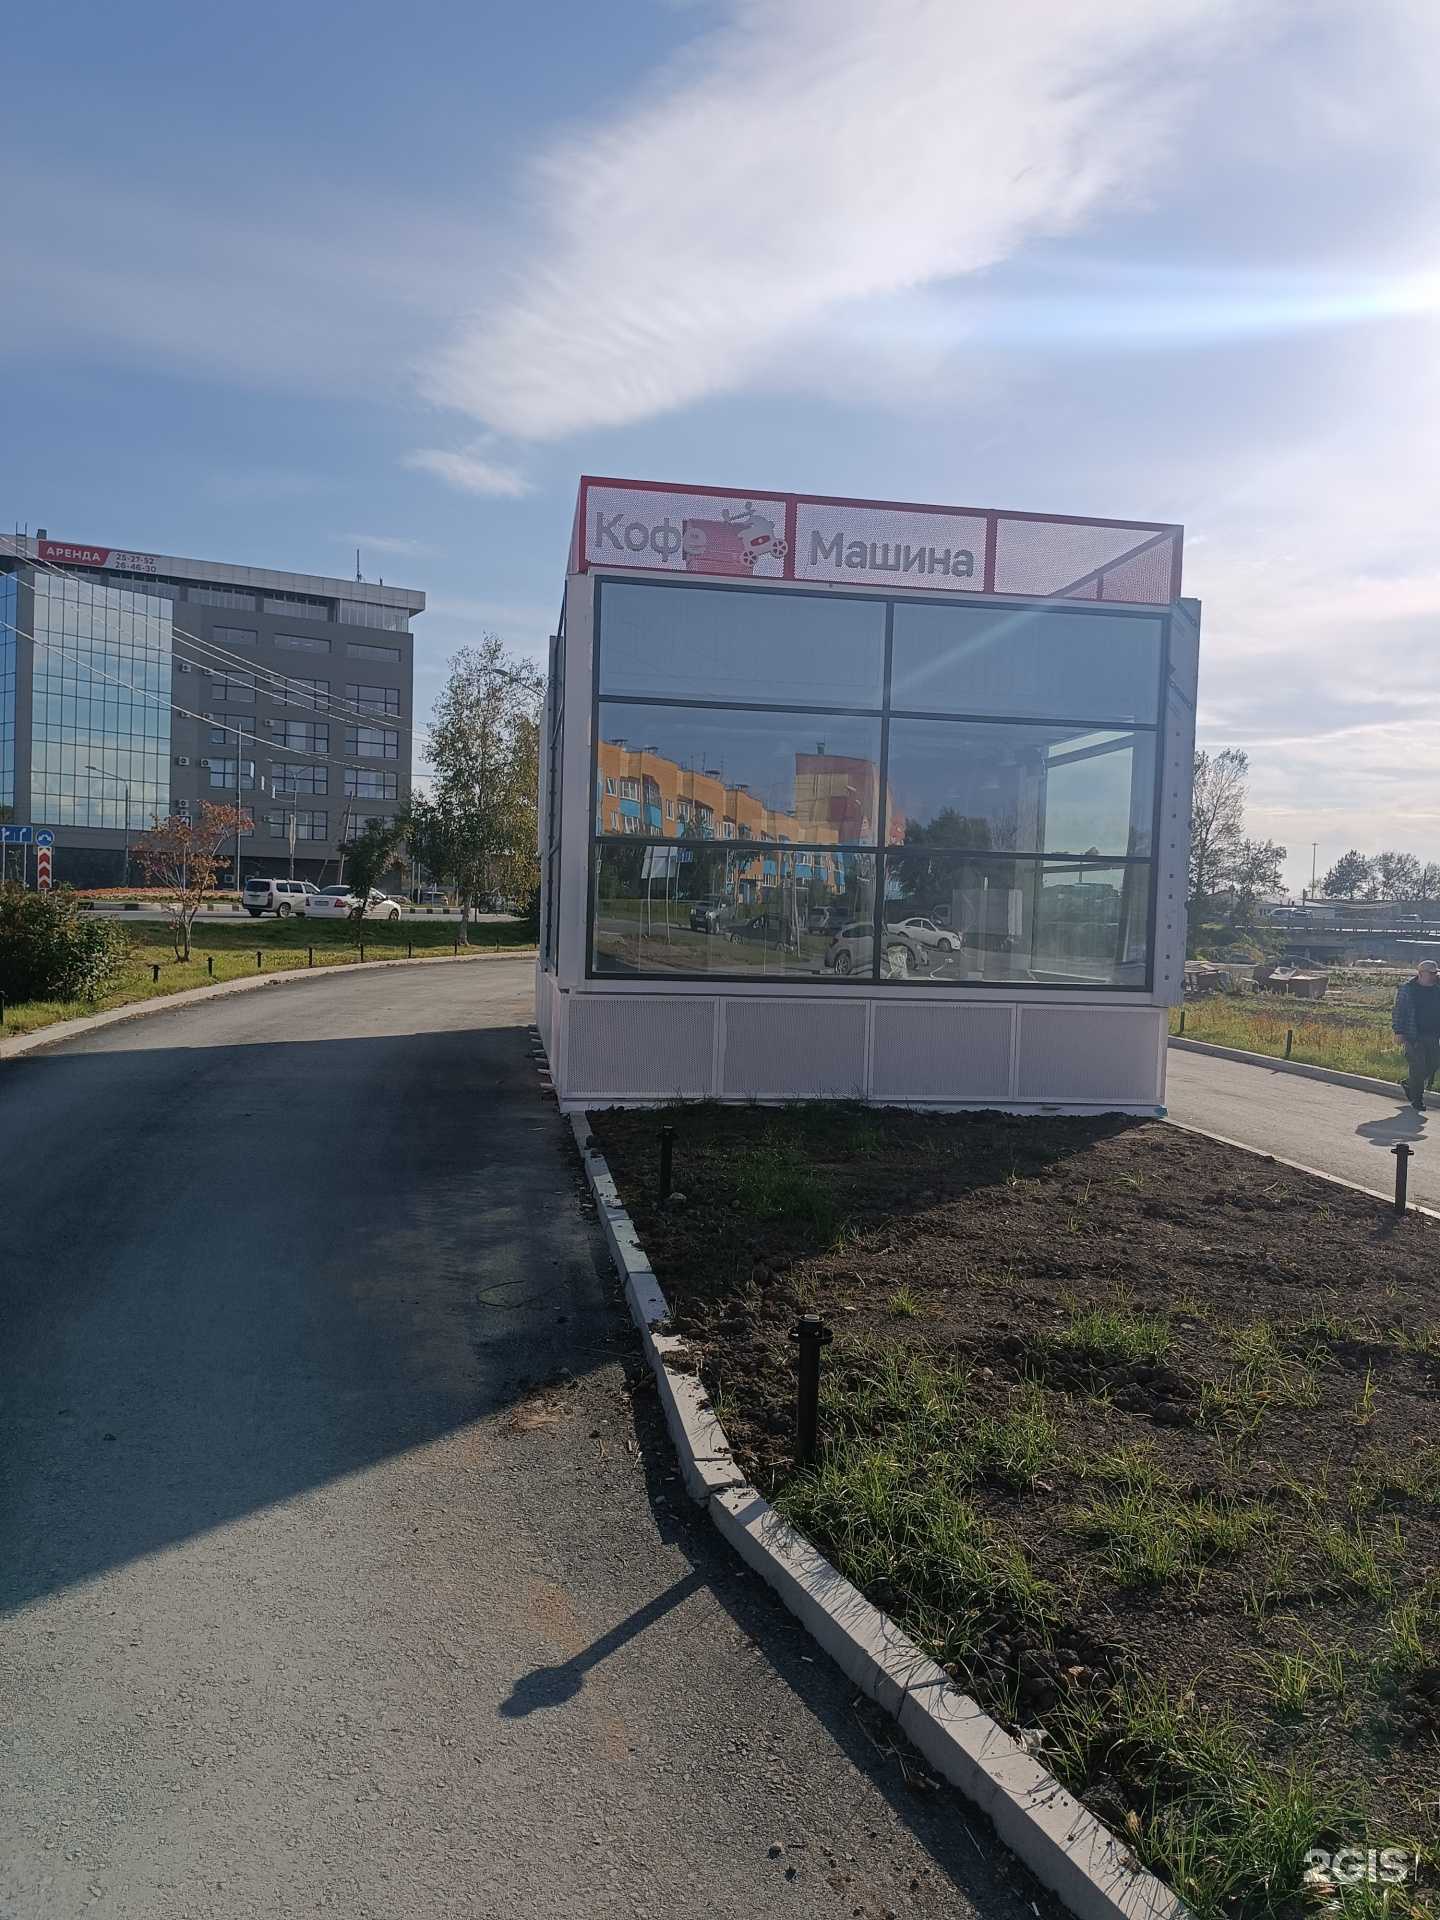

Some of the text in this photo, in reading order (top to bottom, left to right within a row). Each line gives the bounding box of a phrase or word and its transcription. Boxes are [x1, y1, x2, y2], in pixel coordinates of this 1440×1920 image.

[46, 547, 100, 561] АРЕНДА
[595, 512, 974, 578] Кофе Машина
